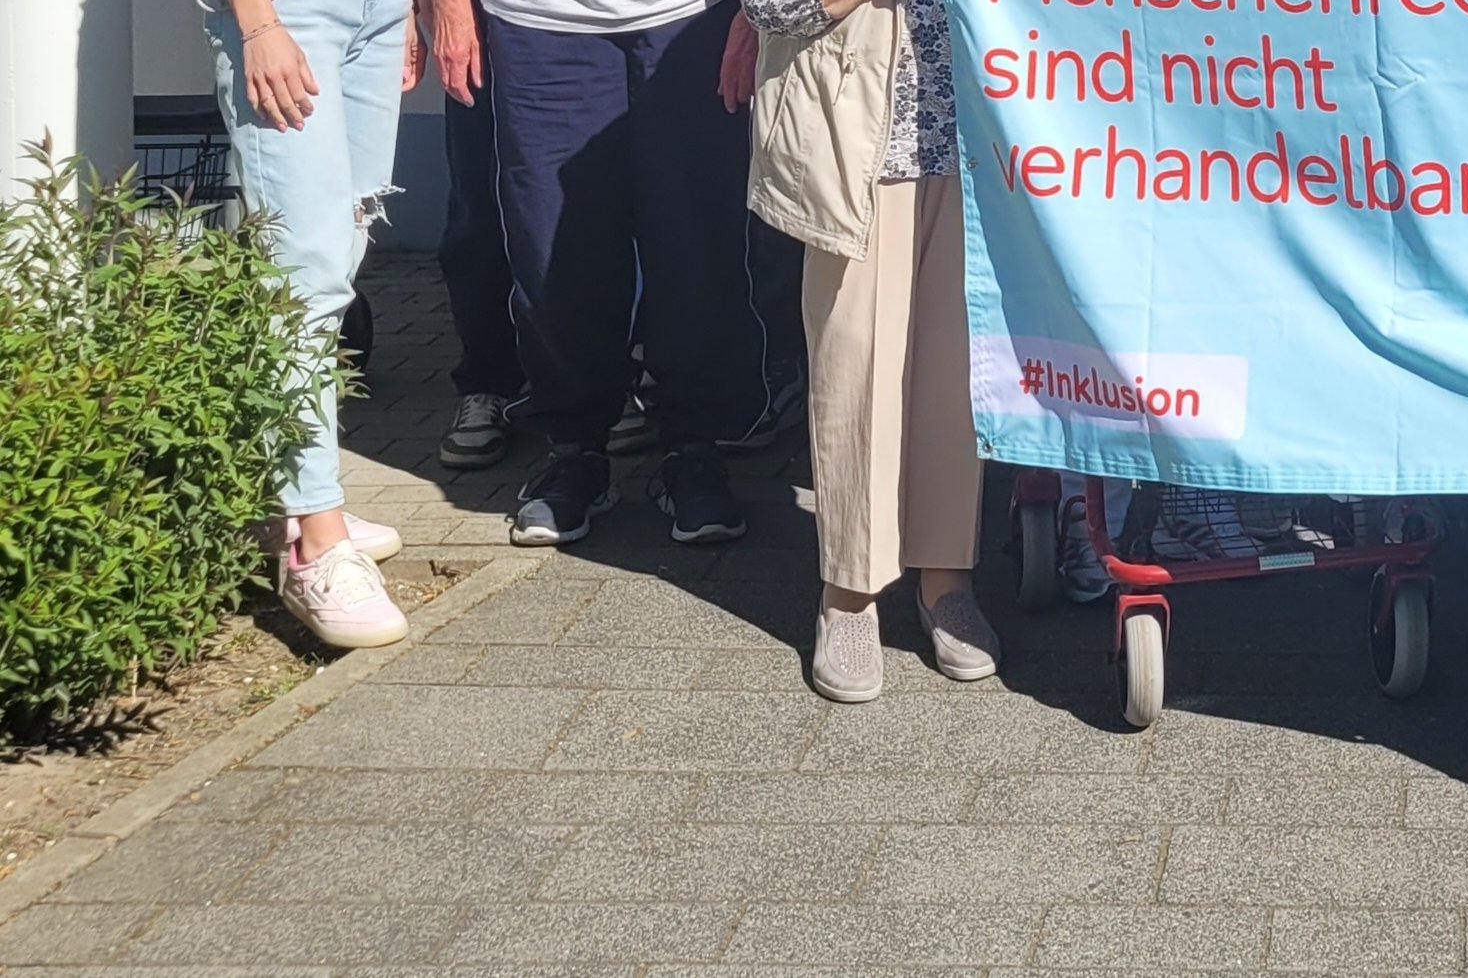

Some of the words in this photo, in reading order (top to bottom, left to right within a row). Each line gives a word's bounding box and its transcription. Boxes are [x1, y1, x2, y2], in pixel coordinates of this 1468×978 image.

[982, 29, 1135, 103] sind
[1160, 34, 1338, 112] nicht
[1019, 358, 1200, 418] #Inklusion
